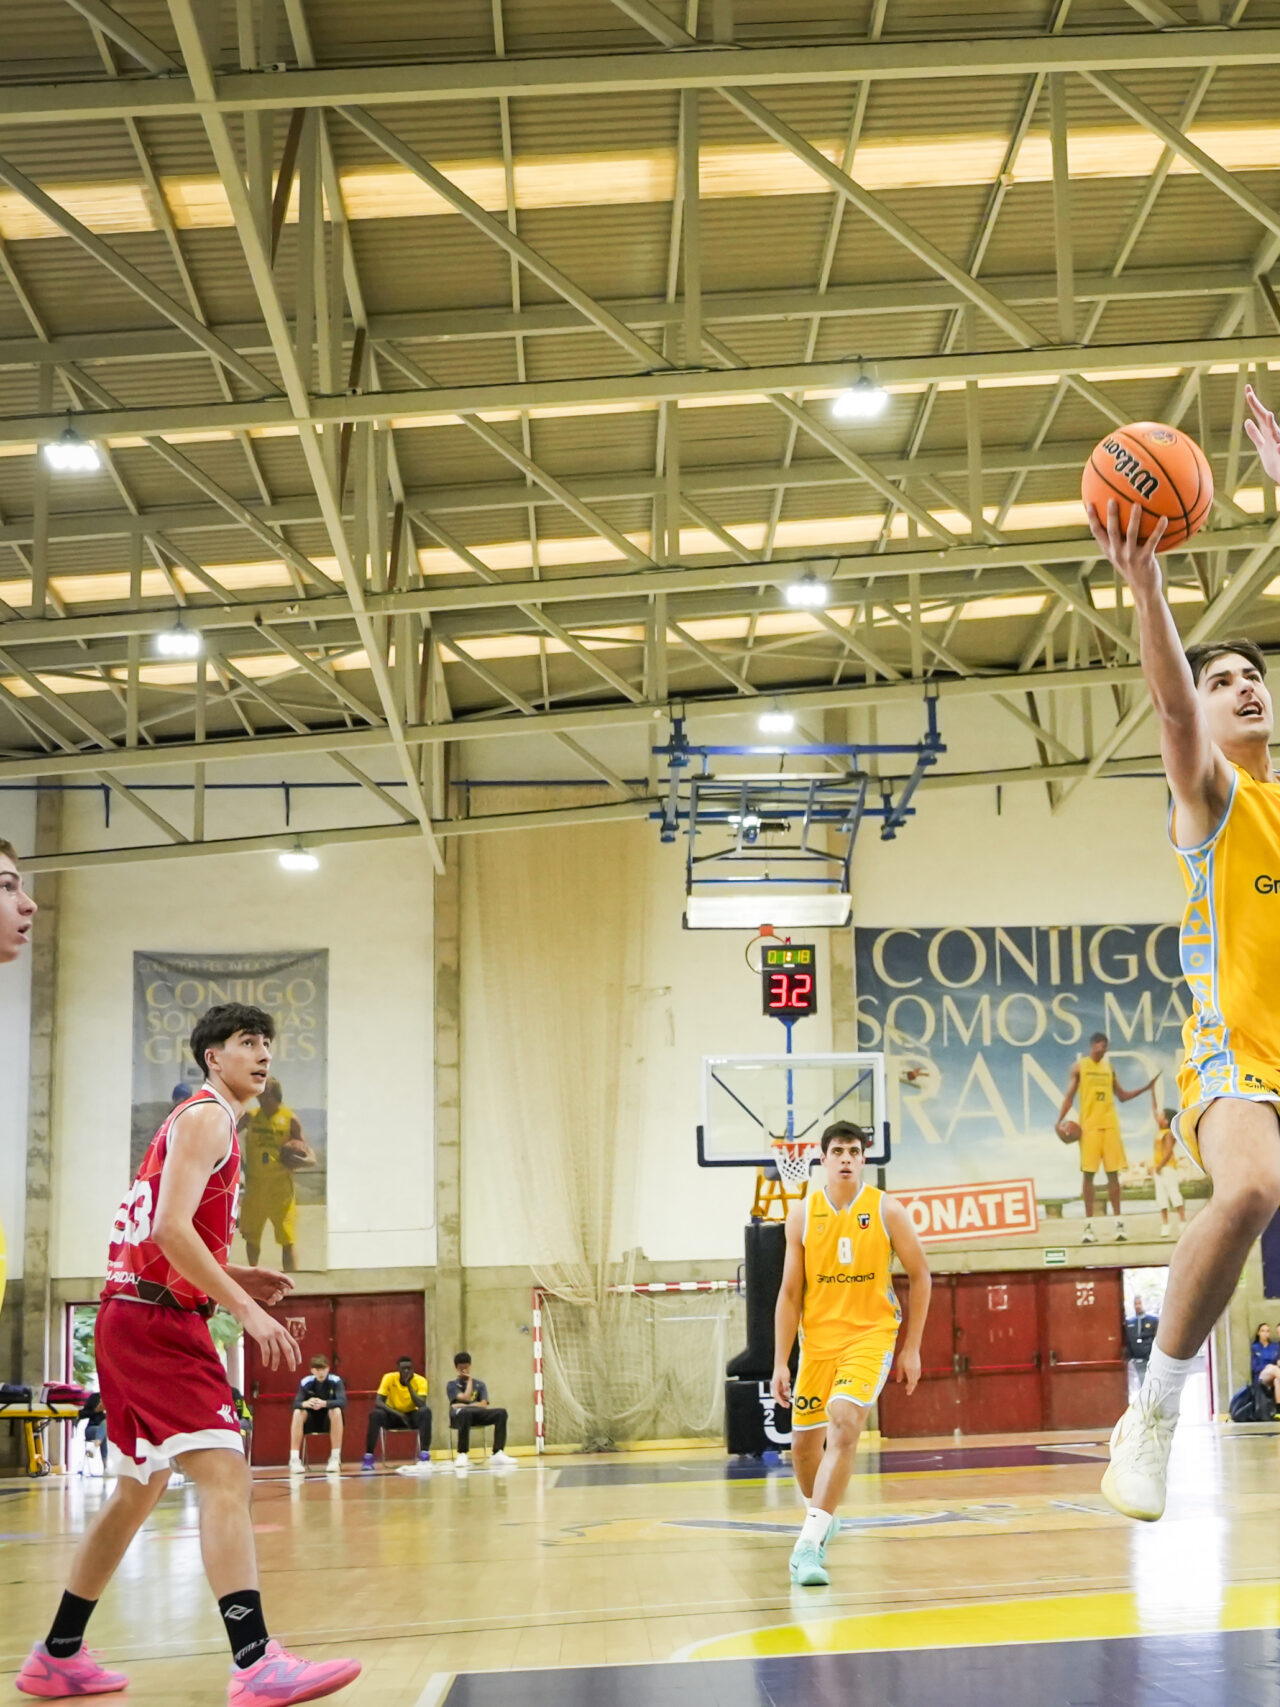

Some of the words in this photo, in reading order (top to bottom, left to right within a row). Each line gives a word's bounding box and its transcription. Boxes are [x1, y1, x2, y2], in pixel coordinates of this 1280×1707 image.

[1103, 437, 1160, 500] Wilson
[872, 924, 1188, 989] CONTIGO
[145, 977, 317, 1009] CONTIGO
[768, 974, 812, 1008] 3.2
[857, 991, 1084, 1049] SOMOS
[1104, 982, 1190, 1043] MÁ
[905, 1191, 1027, 1234] ÓNATE
[838, 1236, 853, 1264] 8
